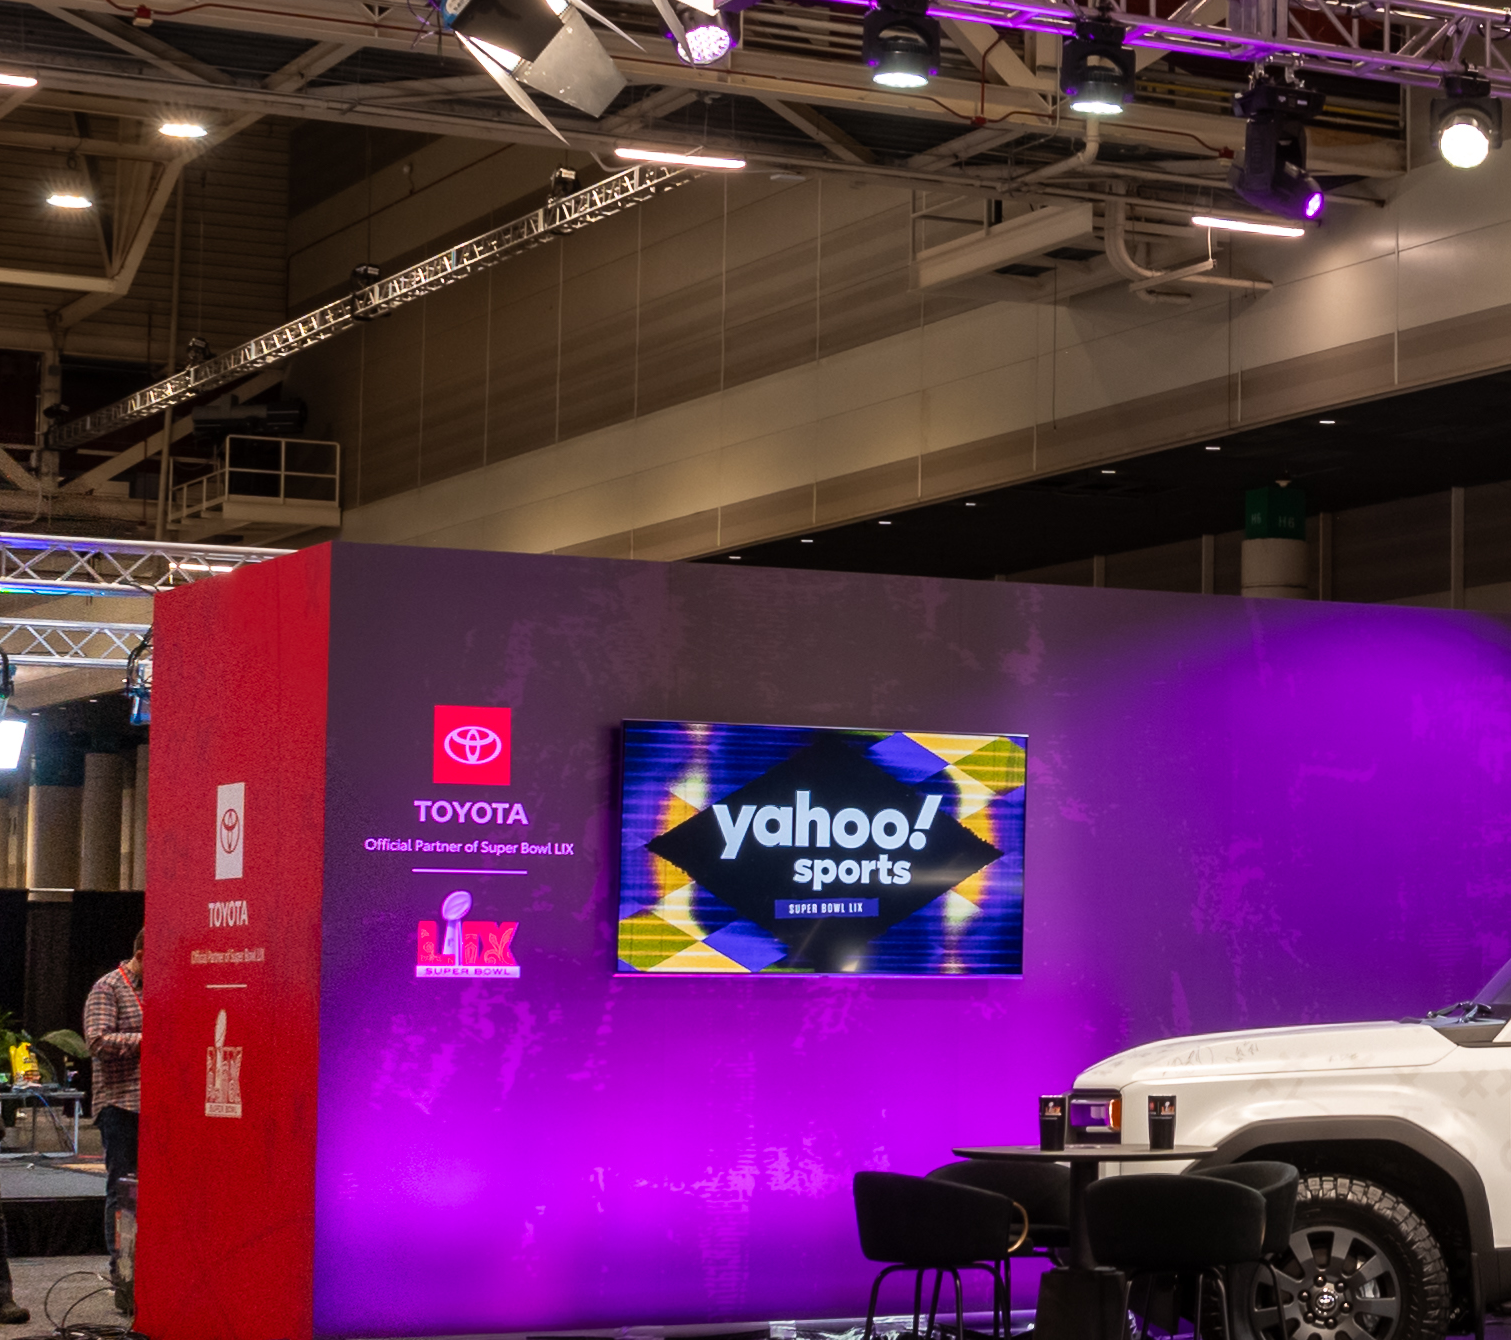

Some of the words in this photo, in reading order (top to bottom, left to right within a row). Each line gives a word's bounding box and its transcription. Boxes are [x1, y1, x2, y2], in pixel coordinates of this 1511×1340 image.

[413, 800, 529, 825] TOYOTA
[712, 790, 943, 860] yahoo!
[364, 838, 412, 851] Official
[415, 839, 462, 853] Partner
[464, 840, 478, 853] of
[480, 841, 518, 856] Super
[520, 842, 552, 854] Bowl
[554, 843, 574, 855] LIX
[793, 854, 912, 891] sports
[208, 901, 248, 928] TOYOTA
[789, 904, 818, 914] SUPER
[821, 903, 845, 913] BOWL
[848, 902, 863, 913] LIX
[425, 967, 469, 976] SUPER
[474, 968, 511, 976] BOWL
